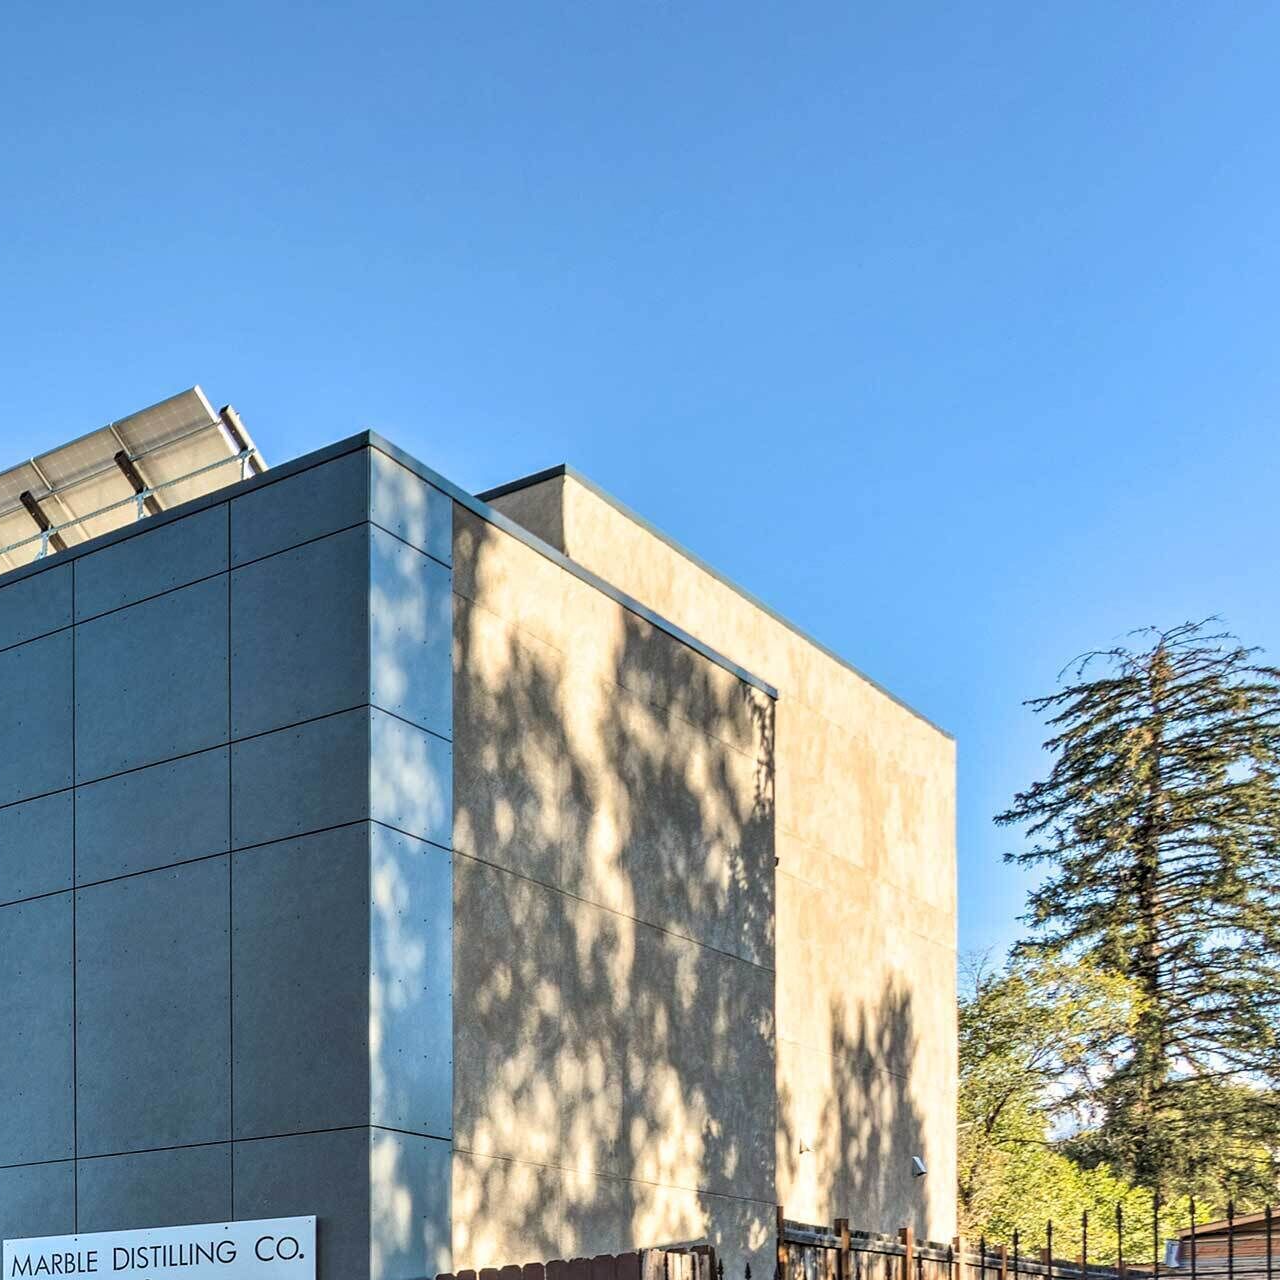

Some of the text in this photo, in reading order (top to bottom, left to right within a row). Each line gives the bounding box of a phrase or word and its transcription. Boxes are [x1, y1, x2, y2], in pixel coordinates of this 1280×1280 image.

[11, 1236, 305, 1278] MARBLE DISTILLING CO.
